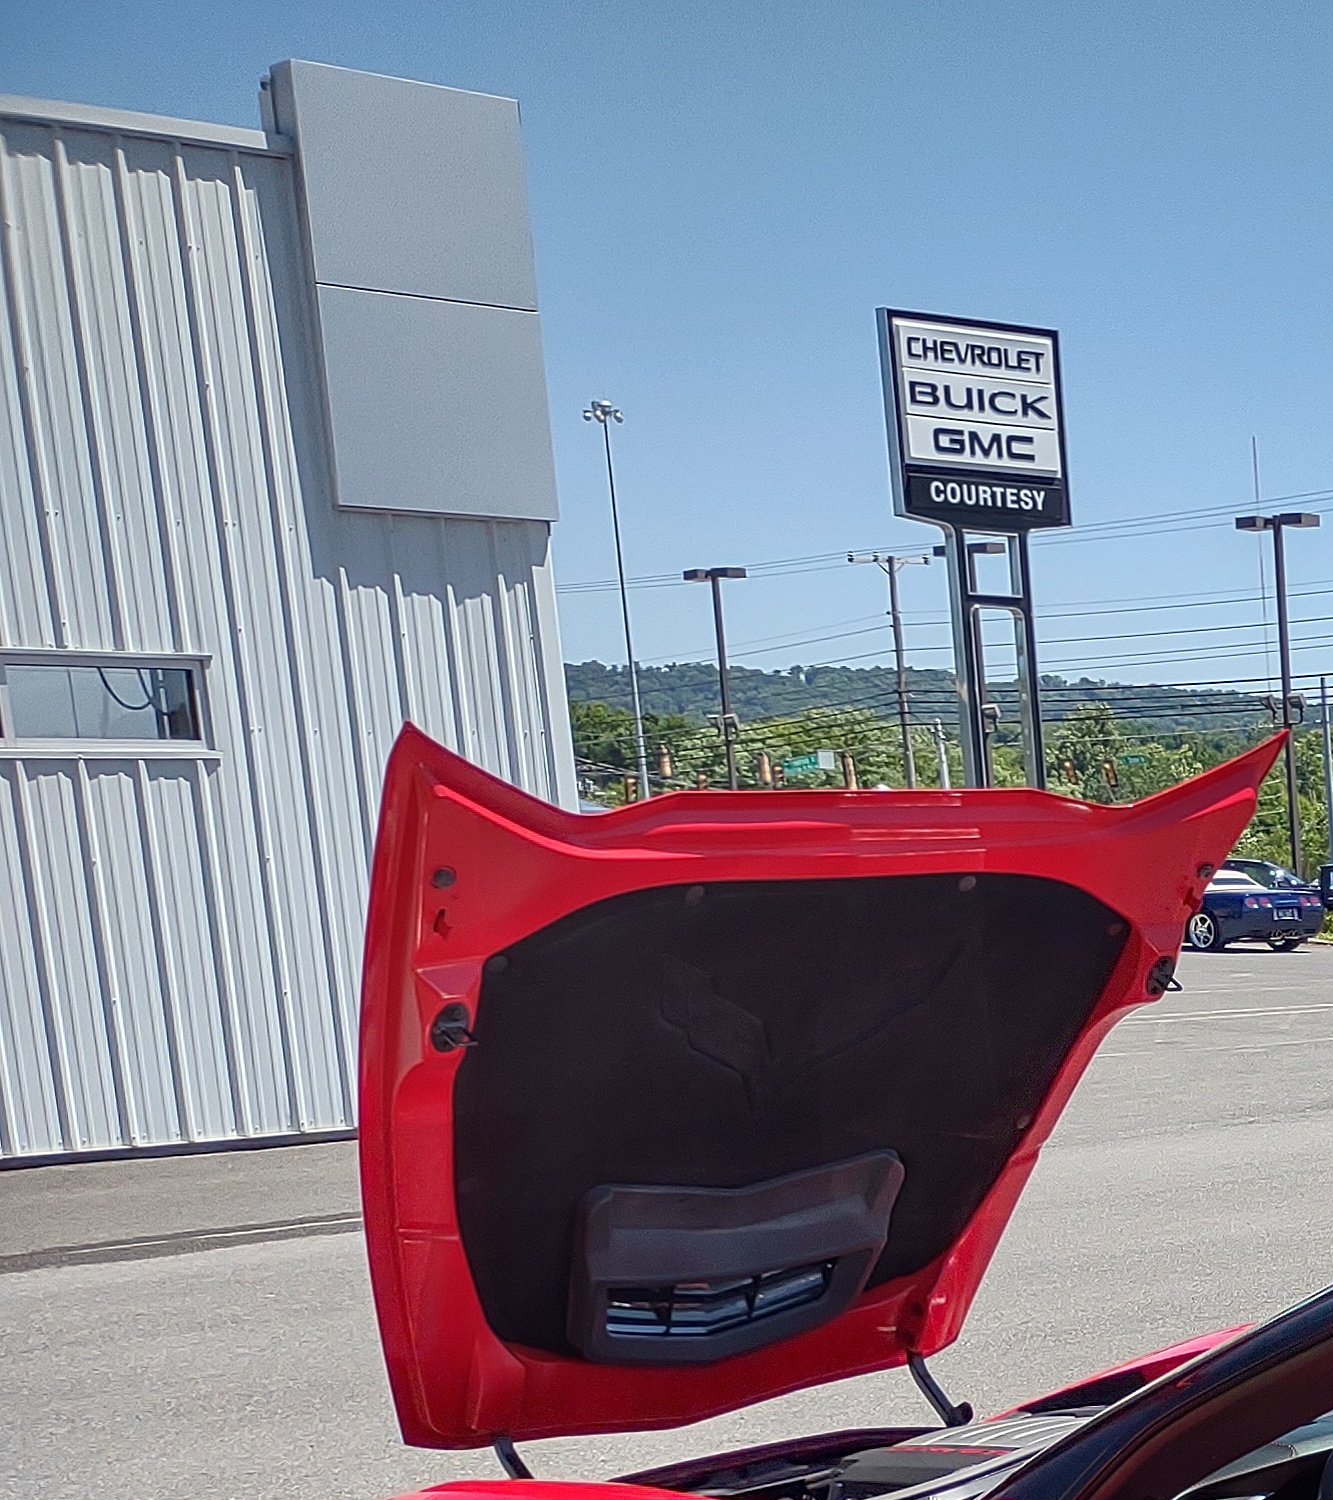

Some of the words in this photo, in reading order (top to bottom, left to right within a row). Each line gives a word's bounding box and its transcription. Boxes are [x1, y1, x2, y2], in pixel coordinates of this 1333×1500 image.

[906, 336, 1046, 375] CHEVROLET
[908, 380, 1052, 420] BUICK
[933, 427, 1036, 463] GMC
[930, 480, 1046, 511] COURTESY
